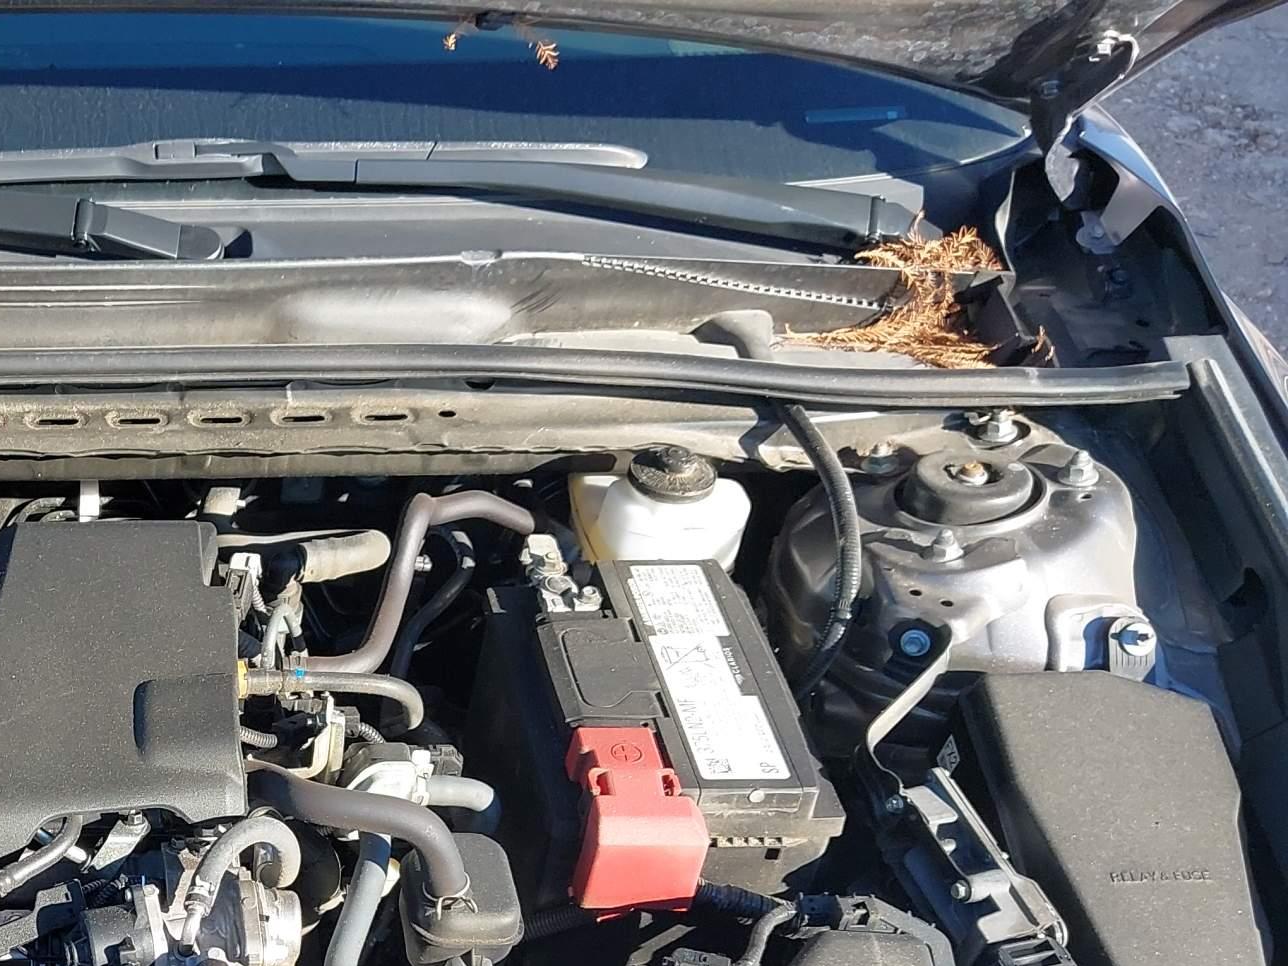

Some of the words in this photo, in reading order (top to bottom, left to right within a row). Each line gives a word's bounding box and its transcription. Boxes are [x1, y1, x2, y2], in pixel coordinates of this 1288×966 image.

[723, 647, 741, 674] CLARIOS
[760, 761, 780, 774] SP
[1109, 871, 1155, 882] RELAY
[1173, 871, 1210, 881] FUSE
